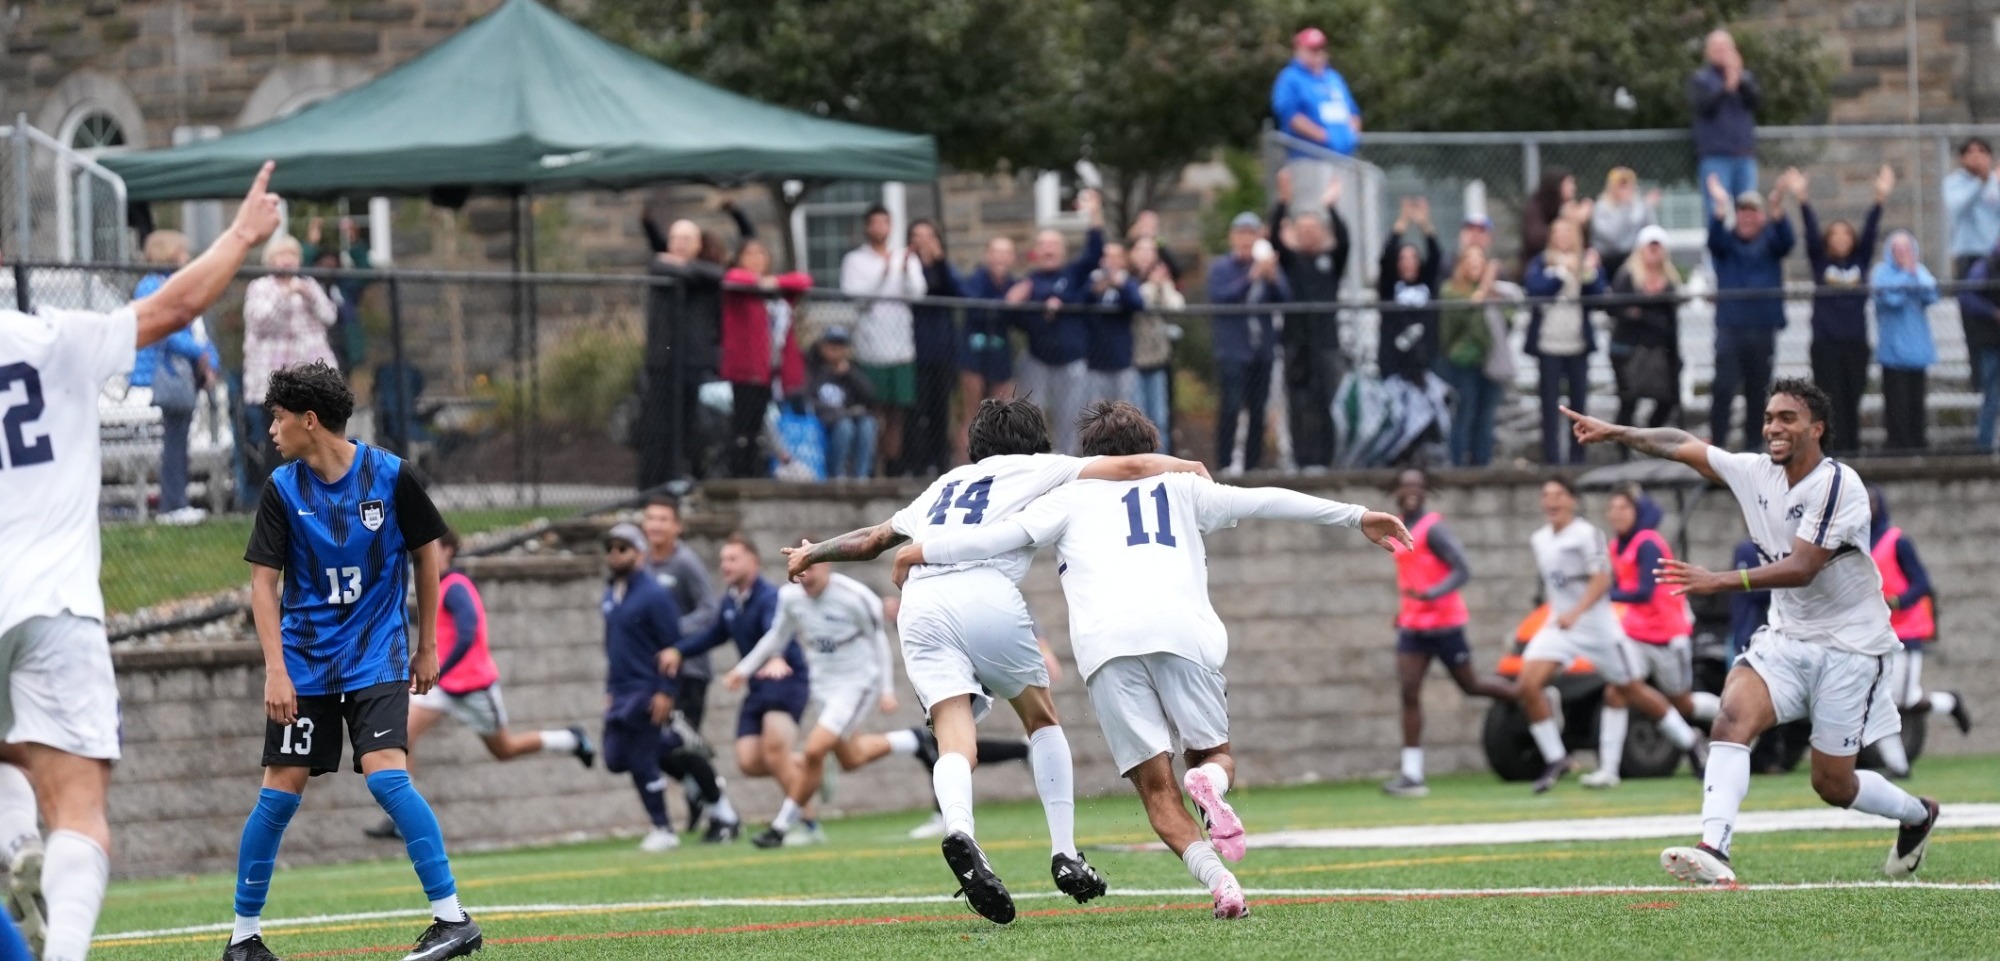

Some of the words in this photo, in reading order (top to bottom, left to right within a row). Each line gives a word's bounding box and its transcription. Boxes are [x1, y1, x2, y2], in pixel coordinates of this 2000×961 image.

[0, 361, 54, 471] 2
[926, 475, 996, 526] 44
[1121, 482, 1177, 548] 11
[326, 566, 362, 605] 13
[280, 717, 315, 756] 13
